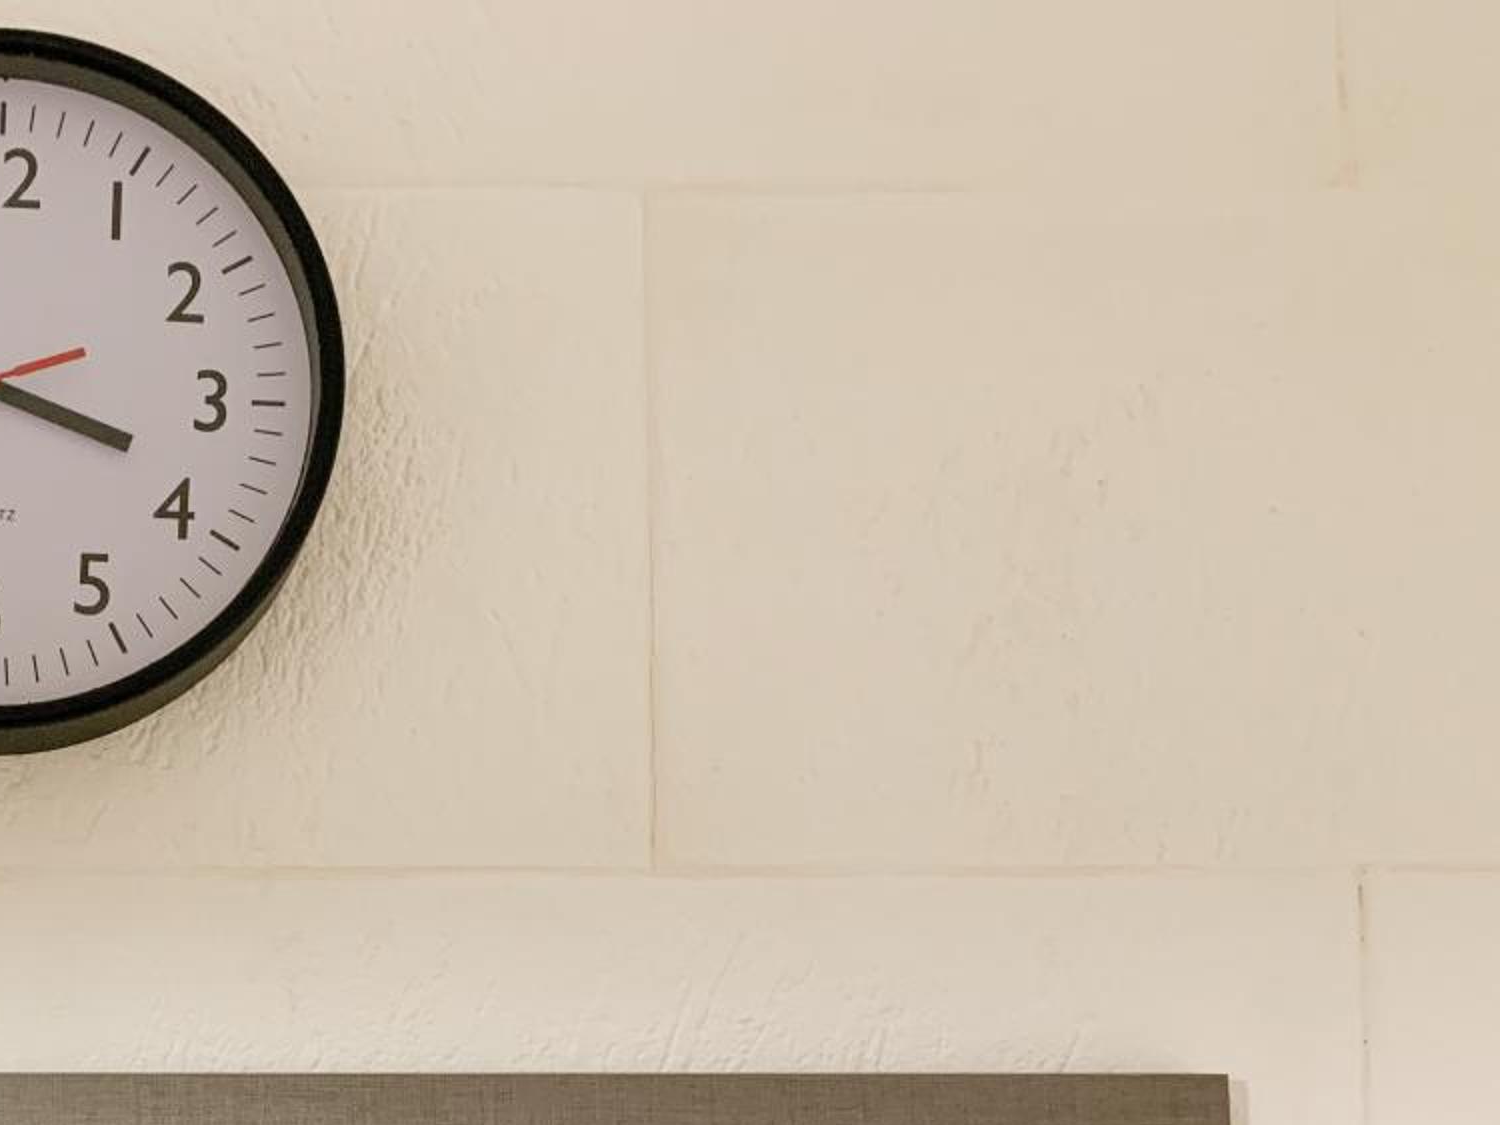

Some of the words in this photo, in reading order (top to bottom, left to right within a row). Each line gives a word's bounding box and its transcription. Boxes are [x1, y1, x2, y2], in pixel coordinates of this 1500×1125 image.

[111, 181, 123, 241] 1
[165, 261, 205, 324] 2
[193, 369, 228, 433] 3
[153, 477, 195, 541] 4
[73, 552, 110, 616] 5
